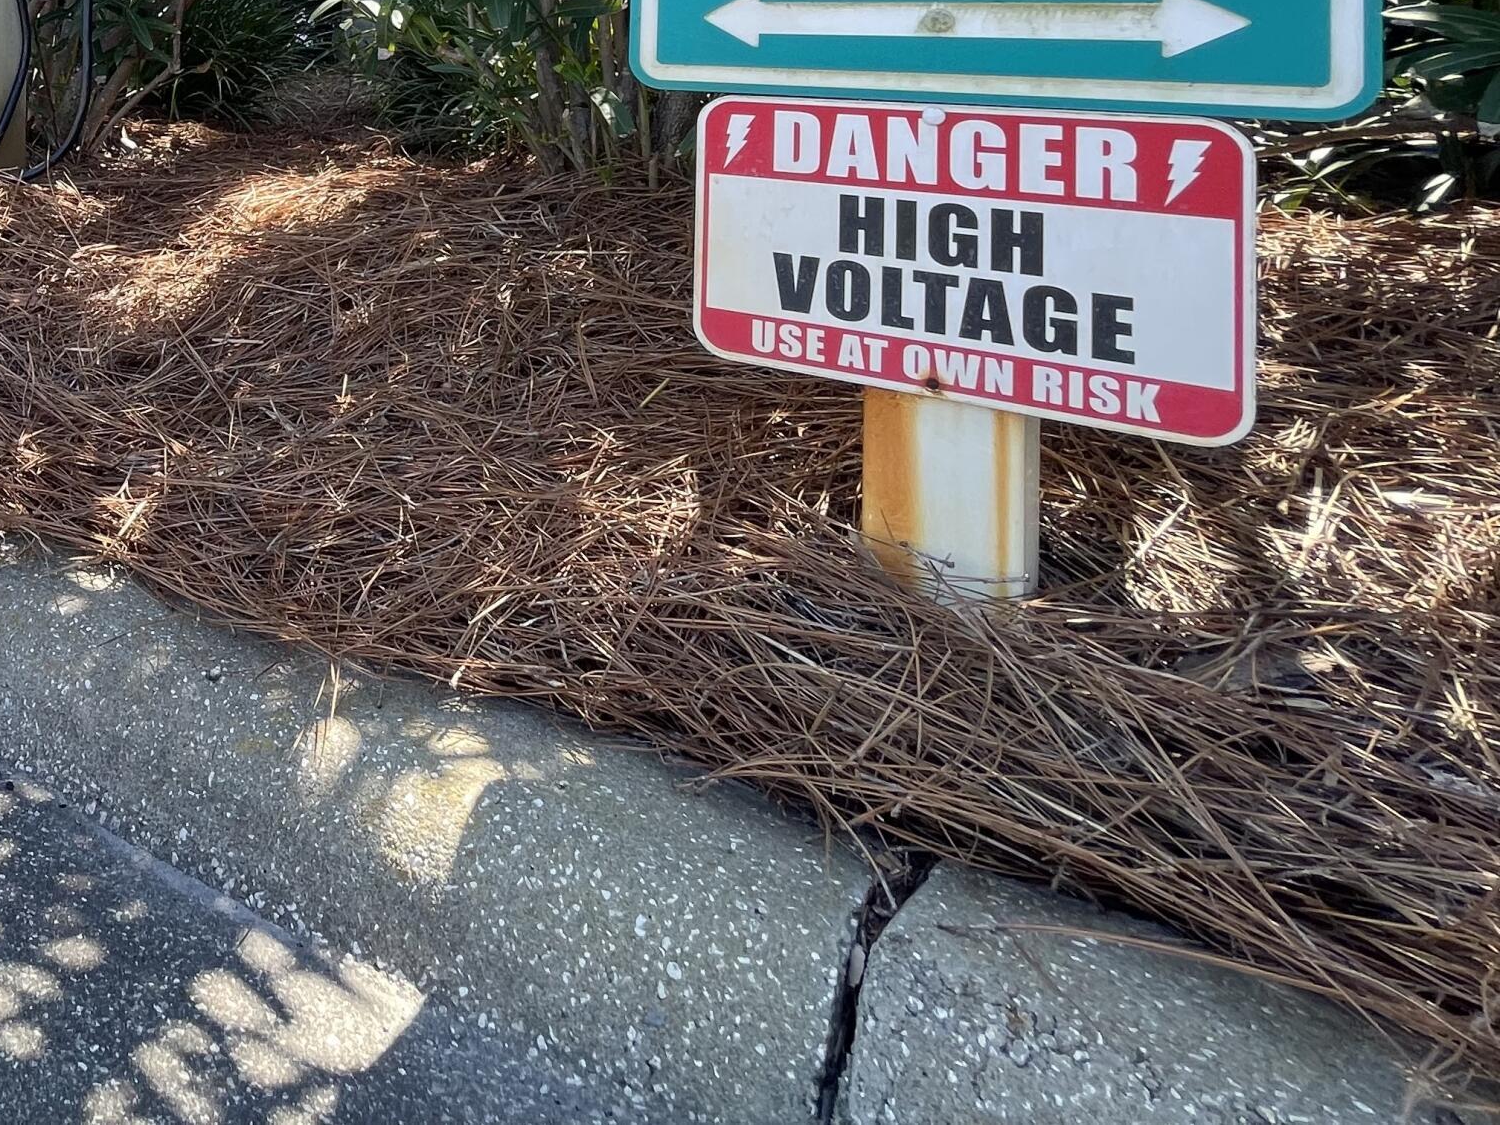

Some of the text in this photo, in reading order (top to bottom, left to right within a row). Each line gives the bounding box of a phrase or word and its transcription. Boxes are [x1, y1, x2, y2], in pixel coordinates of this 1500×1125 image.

[773, 110, 1138, 202] DANGER
[839, 194, 1044, 277] HIGH
[773, 252, 1135, 365] VOLTAGE
[751, 319, 1162, 424] USE AT OWN RISK
